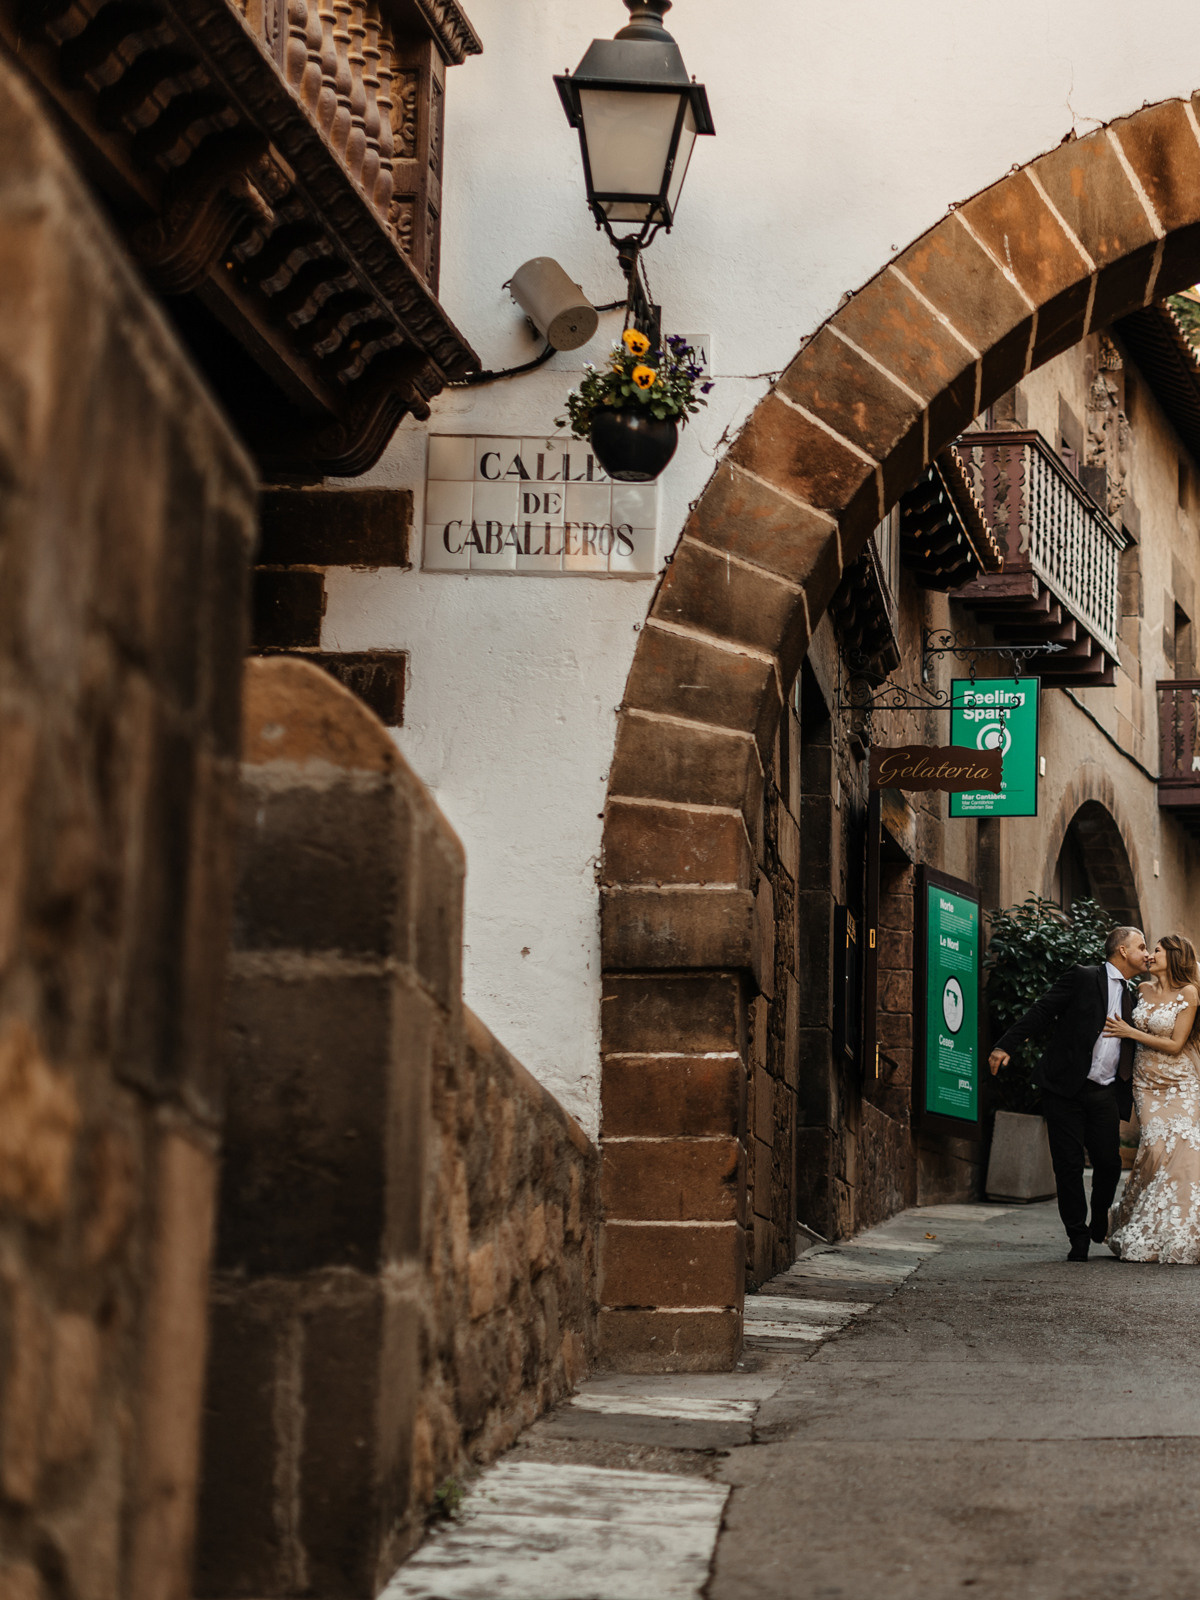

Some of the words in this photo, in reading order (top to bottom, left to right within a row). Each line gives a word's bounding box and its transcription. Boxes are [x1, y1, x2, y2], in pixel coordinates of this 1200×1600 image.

[479, 451, 608, 482] CALLE
[523, 492, 562, 515] DE
[443, 519, 635, 557] CABALLEROS
[963, 690, 1026, 706] Feeling
[963, 705, 1011, 722] Spain
[877, 752, 992, 785] Gelateria
[940, 897, 954, 913] Norte
[940, 934, 946, 947] Le
[947, 937, 959, 951] Nord
